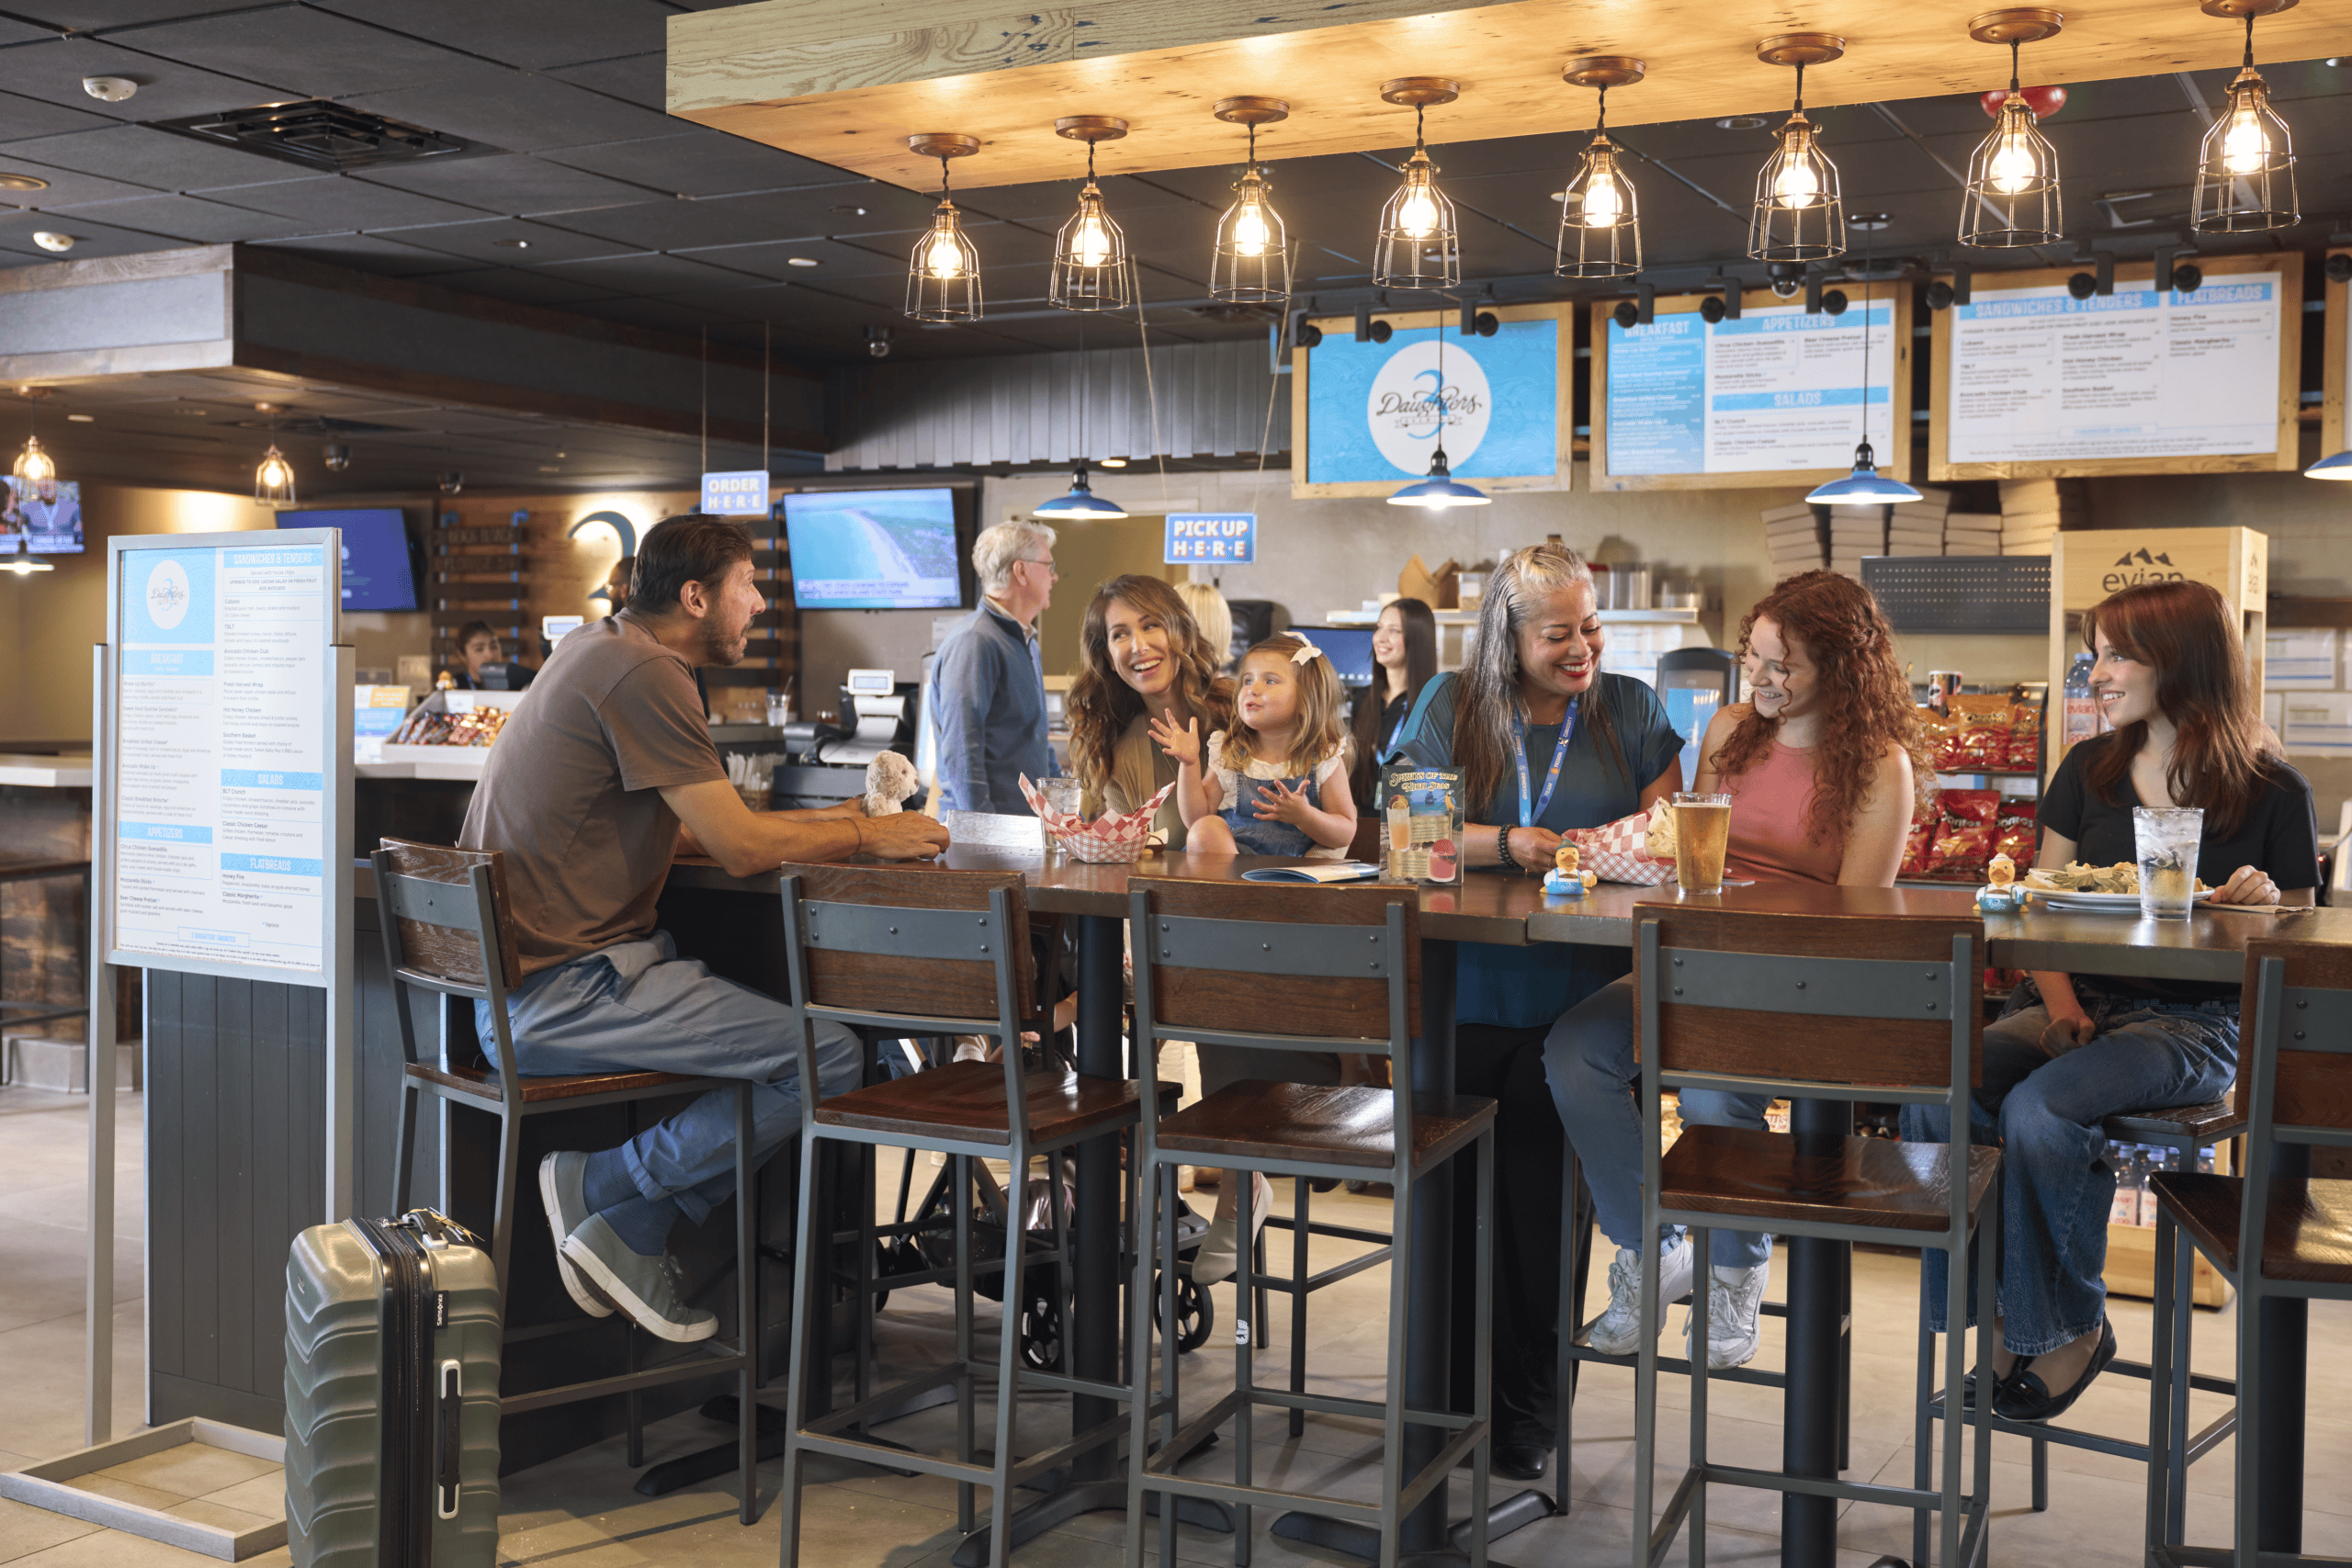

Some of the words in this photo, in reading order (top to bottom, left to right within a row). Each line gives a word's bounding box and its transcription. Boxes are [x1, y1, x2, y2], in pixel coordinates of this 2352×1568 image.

[1975, 299, 2063, 317] SANDWICHES
[1624, 320, 1690, 338] BREAKFAST
[1762, 313, 1836, 332] APPETIZERS
[1376, 386, 1482, 417] Daughters
[1774, 392, 1821, 406] SALADS
[708, 478, 760, 494] ORDER
[1174, 520, 1220, 537] PICK
[1221, 520, 1248, 537] UP
[233, 553, 275, 565] SANDWICHES
[283, 552, 313, 564] TENDERS
[1563, 716, 1572, 737] CURIOSITY
[258, 773, 283, 785] SALADS
[1544, 782, 1553, 796] TEAM
[147, 827, 183, 839] APPETIZERS
[250, 858, 291, 871] FLATBREADS
